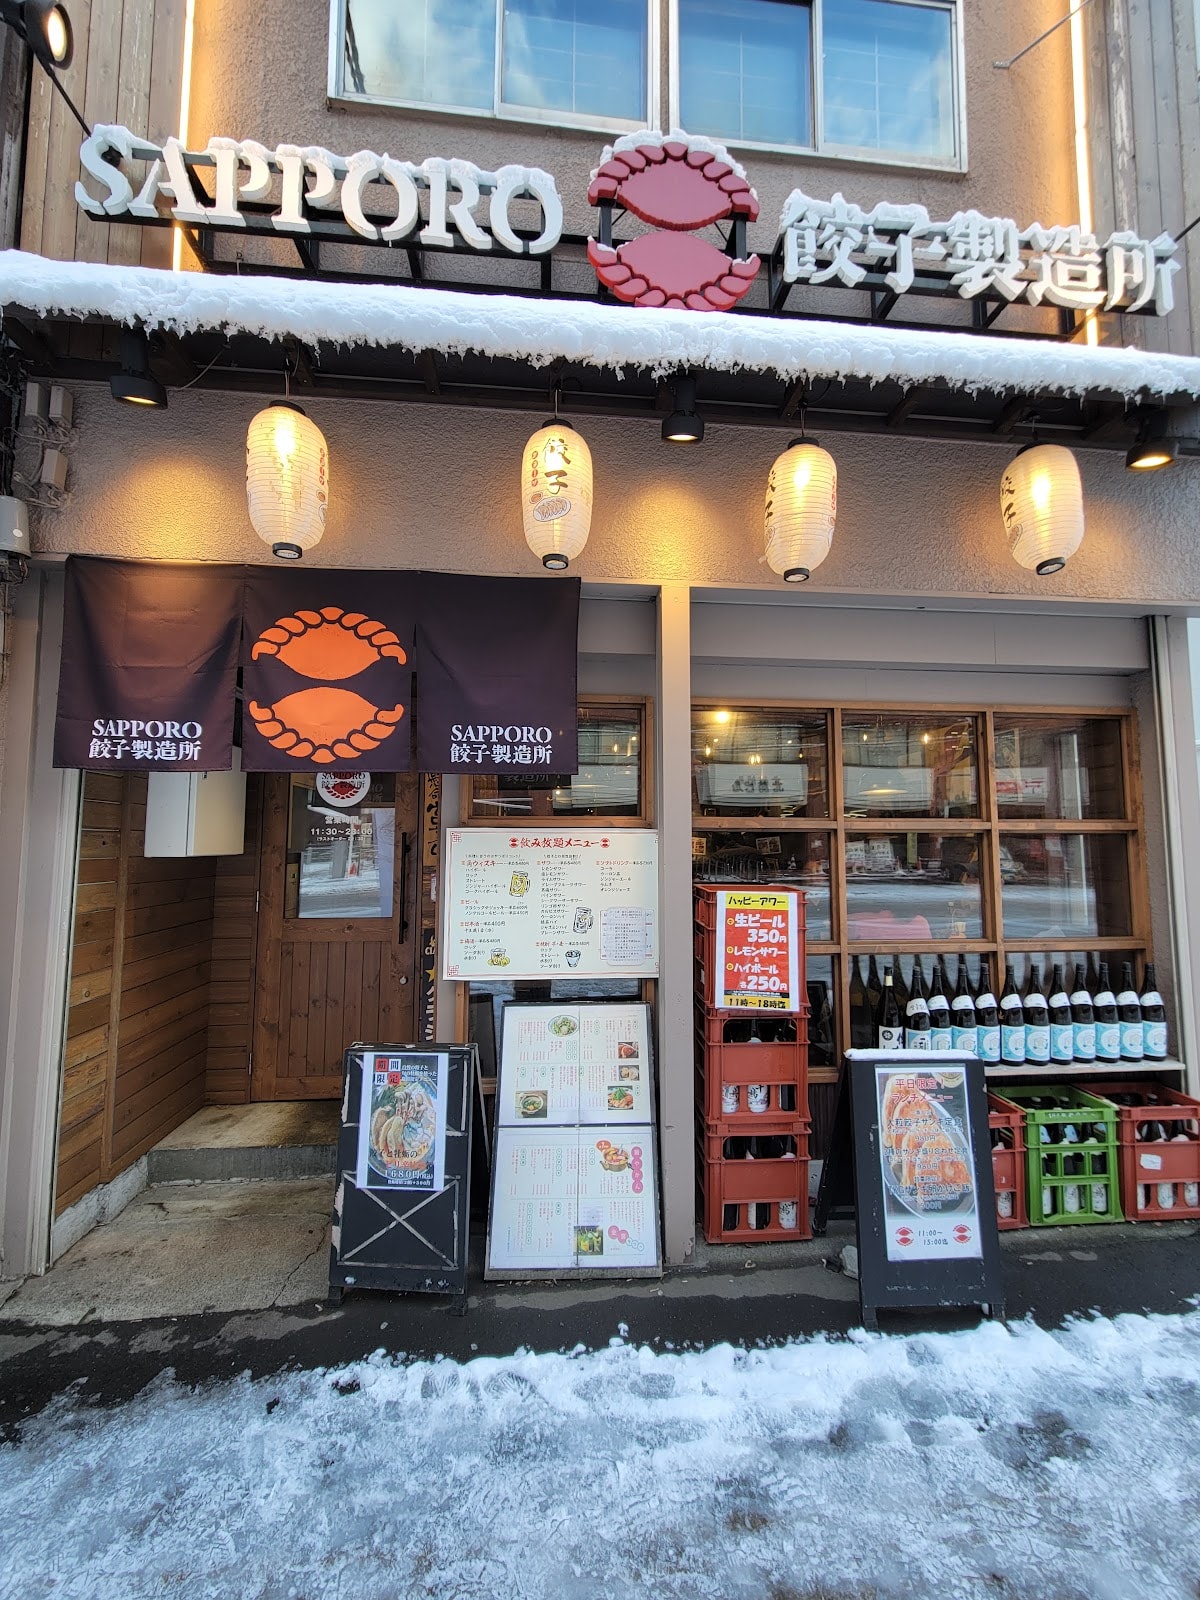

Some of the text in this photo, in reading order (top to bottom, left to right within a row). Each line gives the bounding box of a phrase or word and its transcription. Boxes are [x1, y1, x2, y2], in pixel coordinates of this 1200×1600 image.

[75, 126, 563, 253] SAPPORO
[782, 190, 1182, 316] 餃子製造所
[91, 719, 202, 739] SAPPORO
[450, 724, 552, 743] SAPPORO
[88, 738, 202, 760] 餃子製造所
[449, 743, 552, 764] 餃子製造所
[520, 837, 600, 848] 飲み放題メニュー
[728, 896, 786, 906] ハッピーアワー
[735, 913, 785, 928] 生ビール
[747, 928, 787, 943] 350円
[734, 946, 787, 957] レモンサワー
[734, 963, 779, 974] ハイボール
[740, 976, 787, 991] 各250円
[377, 1060, 399, 1070] 期間
[376, 1073, 398, 1084] 限定
[891, 1093, 953, 1104] ランチメニュー
